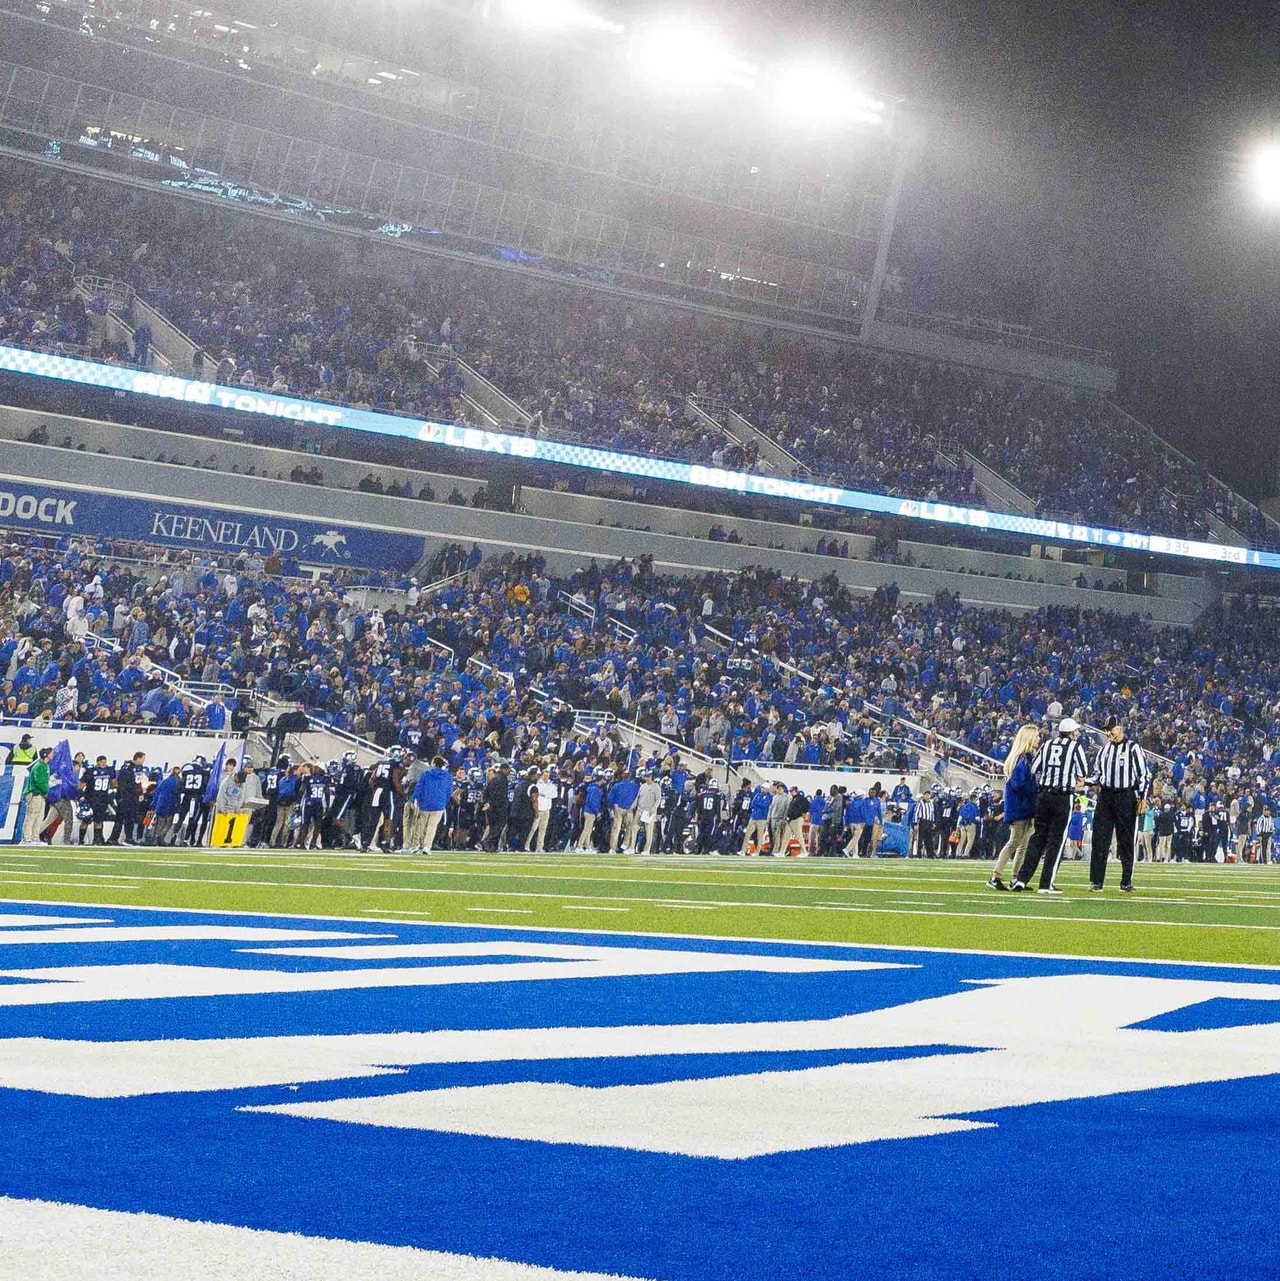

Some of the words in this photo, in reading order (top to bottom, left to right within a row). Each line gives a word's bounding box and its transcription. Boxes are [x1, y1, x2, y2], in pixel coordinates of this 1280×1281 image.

[216, 391, 342, 426] TONIGHT
[750, 475, 844, 504] TONIGHT
[150, 512, 299, 552] KEENELAND
[1048, 744, 1062, 766] R
[185, 774, 202, 789] 23
[224, 817, 236, 843] 1
